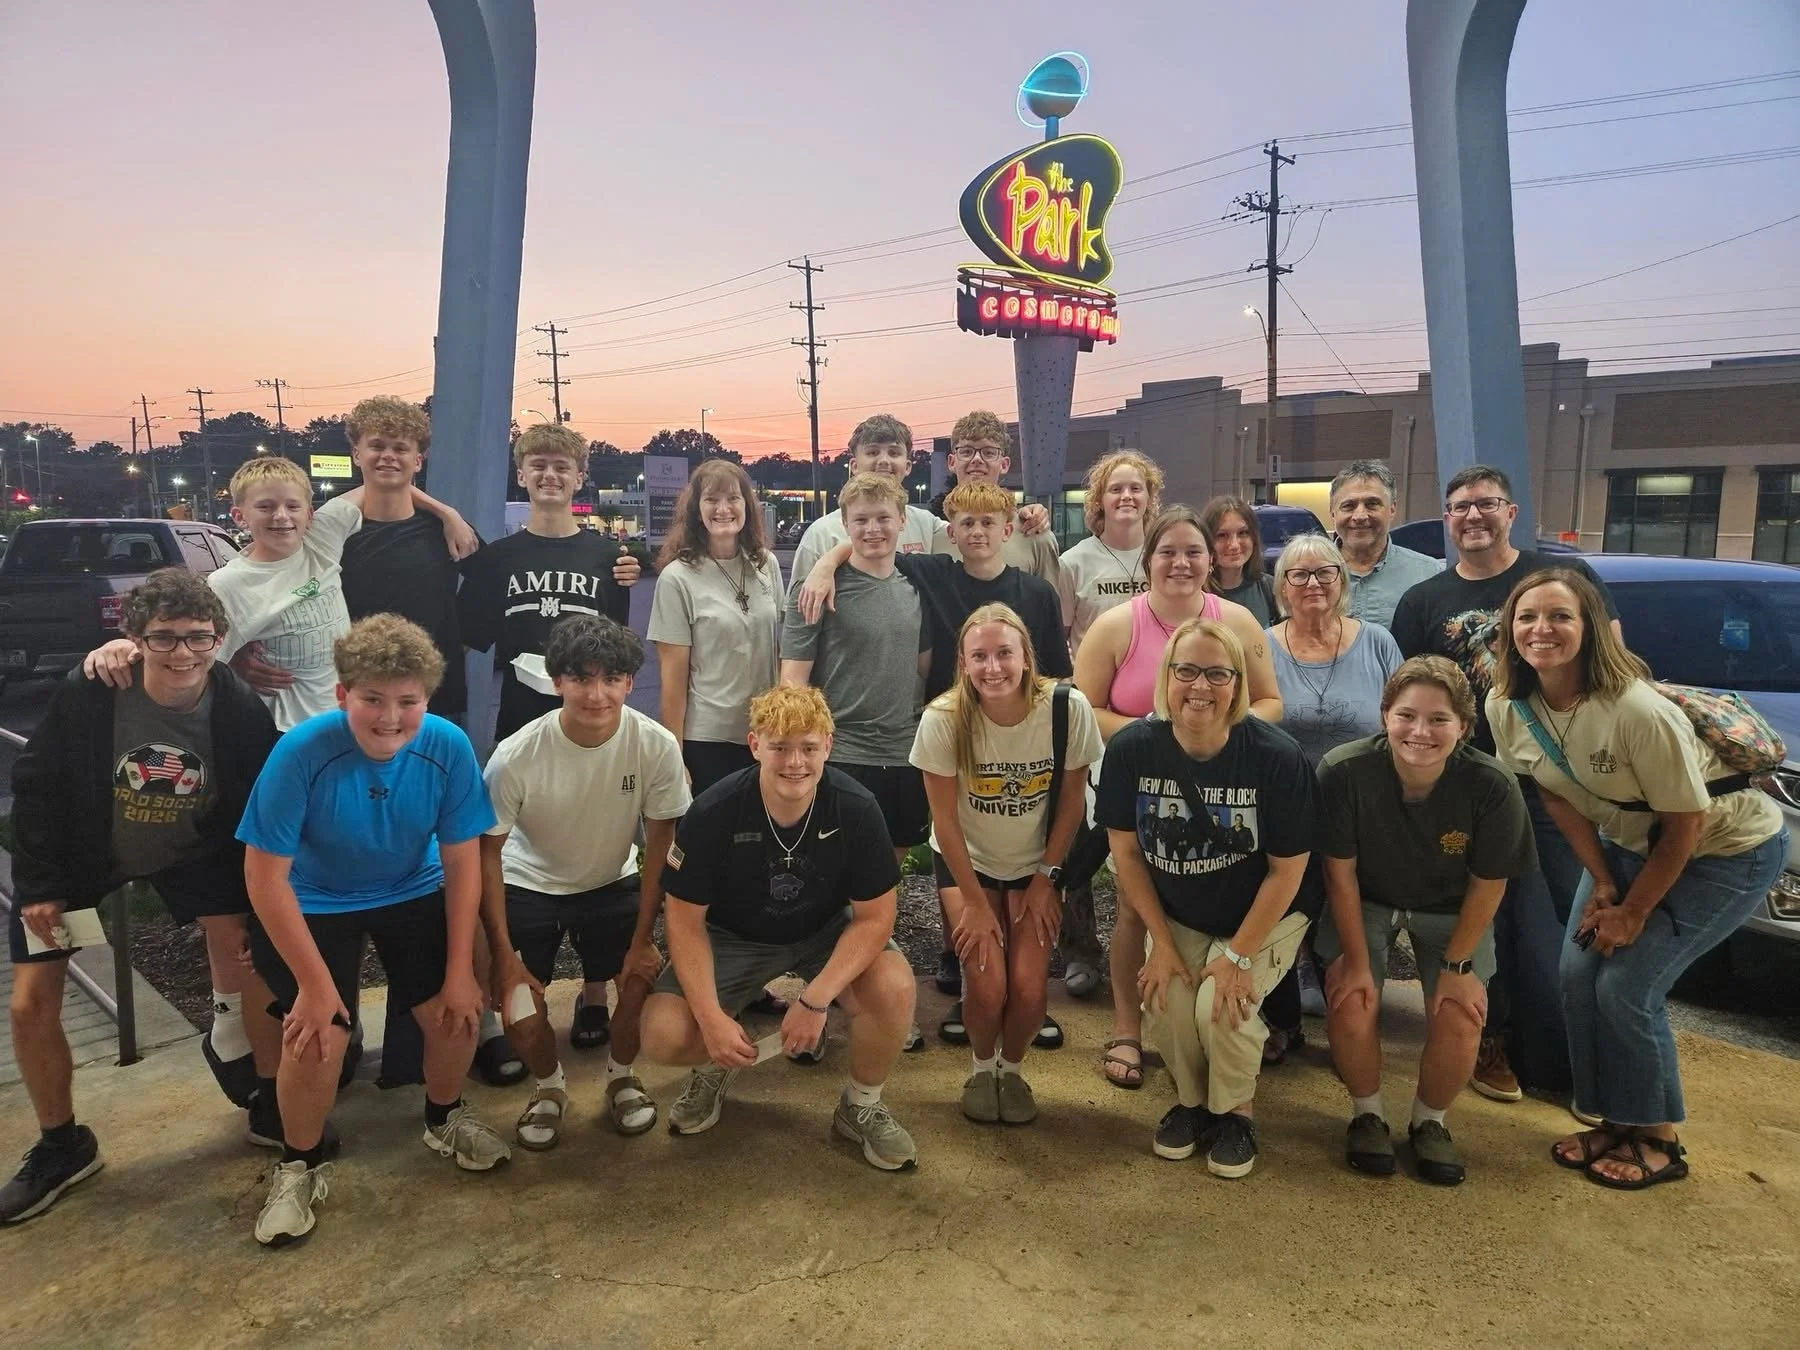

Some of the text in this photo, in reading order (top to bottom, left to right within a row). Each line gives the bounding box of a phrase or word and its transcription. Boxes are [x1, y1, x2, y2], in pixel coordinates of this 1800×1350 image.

[1048, 160, 1074, 193] the
[1007, 161, 1102, 271] Park
[507, 571, 600, 598] AMIRI
[1097, 582, 1130, 595] NIKE
[280, 587, 338, 632] DERBY
[262, 622, 345, 669] SOCC
[976, 758, 1054, 772] RT HAYS STA
[113, 787, 197, 809] RLD SOCC
[1138, 776, 1160, 794] NEW
[1163, 779, 1184, 797] KID
[1203, 787, 1224, 804] THE
[1226, 788, 1257, 806] BLOCK
[124, 805, 178, 823] 2026
[968, 796, 1044, 817] UNIVERSI
[1154, 855, 1181, 875] TOTAL
[1183, 854, 1228, 875] PACKAGE
